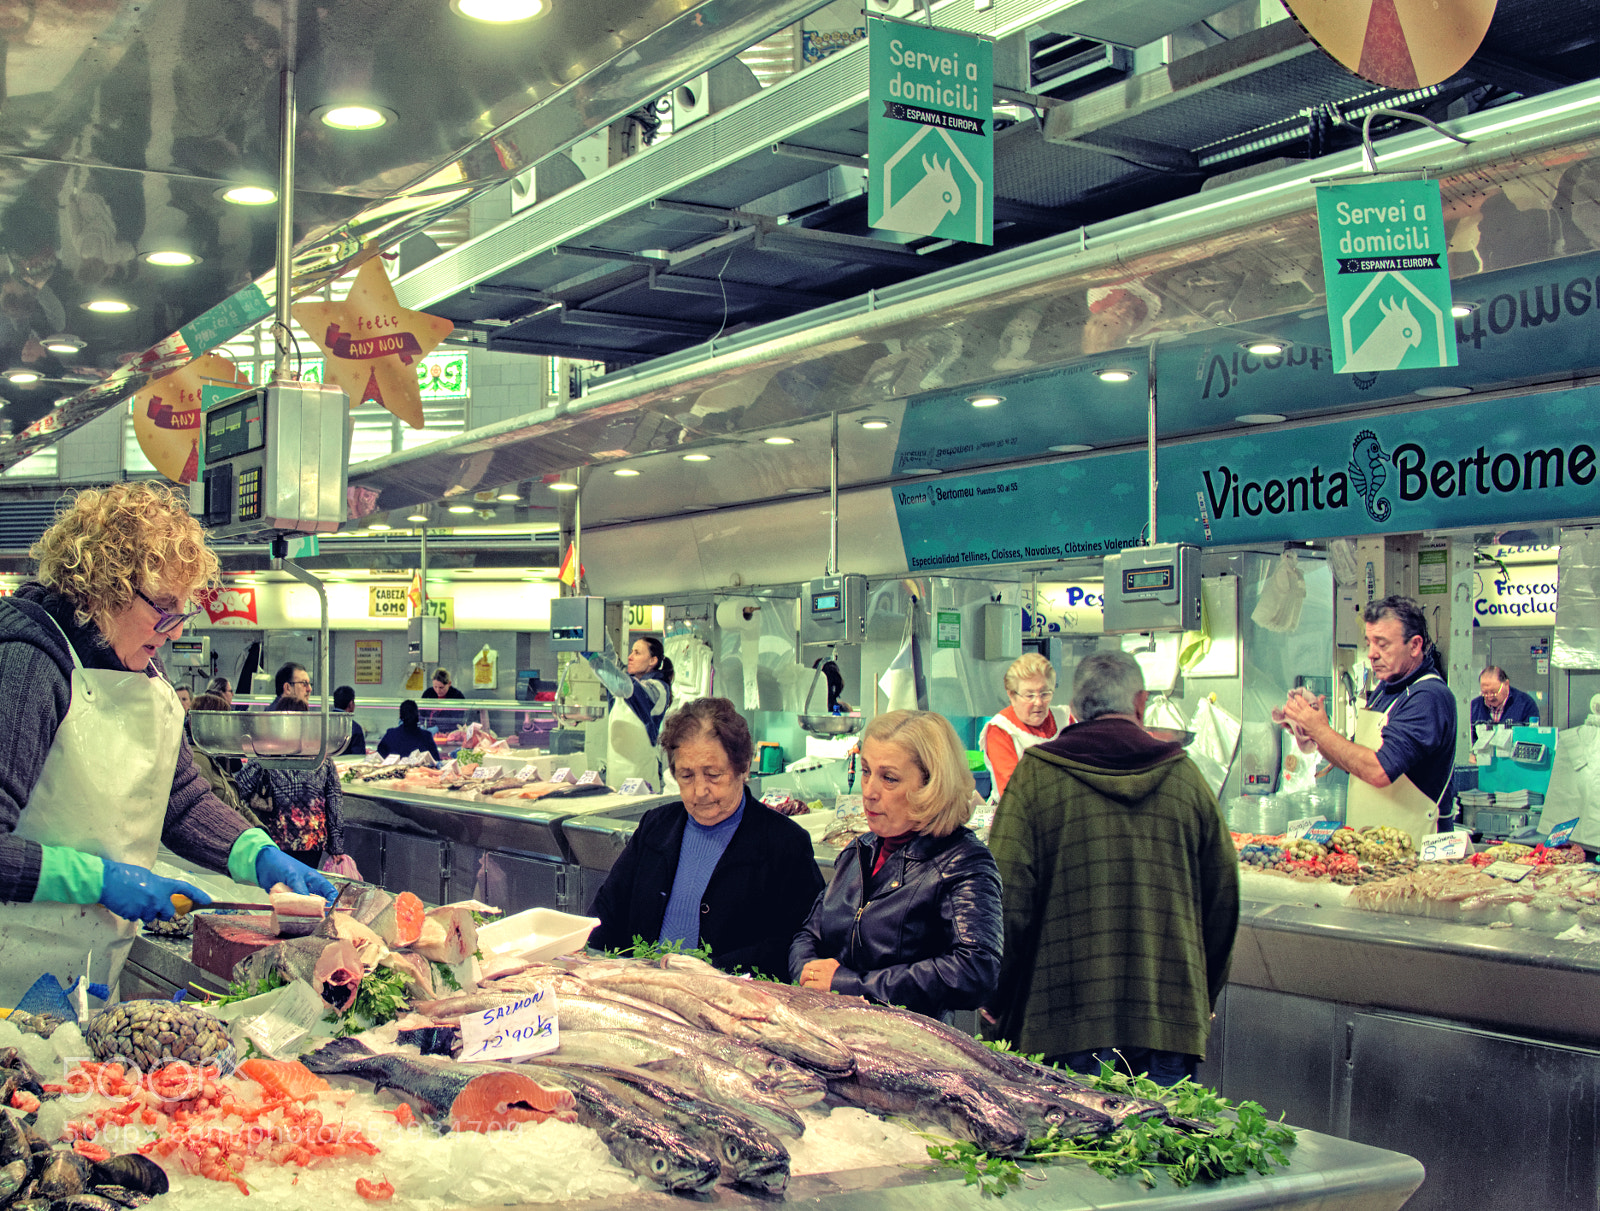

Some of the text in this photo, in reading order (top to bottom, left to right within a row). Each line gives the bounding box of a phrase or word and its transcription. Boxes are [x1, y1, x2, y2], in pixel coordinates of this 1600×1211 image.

[889, 39, 978, 82] Servei a
[889, 71, 978, 113] domicili
[906, 108, 978, 132] ESPANYA I EUROPA
[1336, 199, 1427, 226] Servei a
[1339, 226, 1430, 254] domicili
[1360, 257, 1434, 270] ESPANYA I EUROPA
[349, 337, 404, 356] ANY NOU
[170, 413, 195, 428] ANY
[898, 492, 927, 506] Vicenta
[935, 487, 974, 501] Bertomeu
[1202, 464, 1349, 520] Vicenta
[961, 551, 990, 562] Tellines,
[1024, 544, 1063, 557] Navaixes,
[376, 589, 406, 600] CABEZA
[1494, 579, 1557, 596] Frescos
[375, 602, 406, 613] LOMO
[1423, 845, 1437, 861] 8
[483, 990, 544, 1026] SALMON
